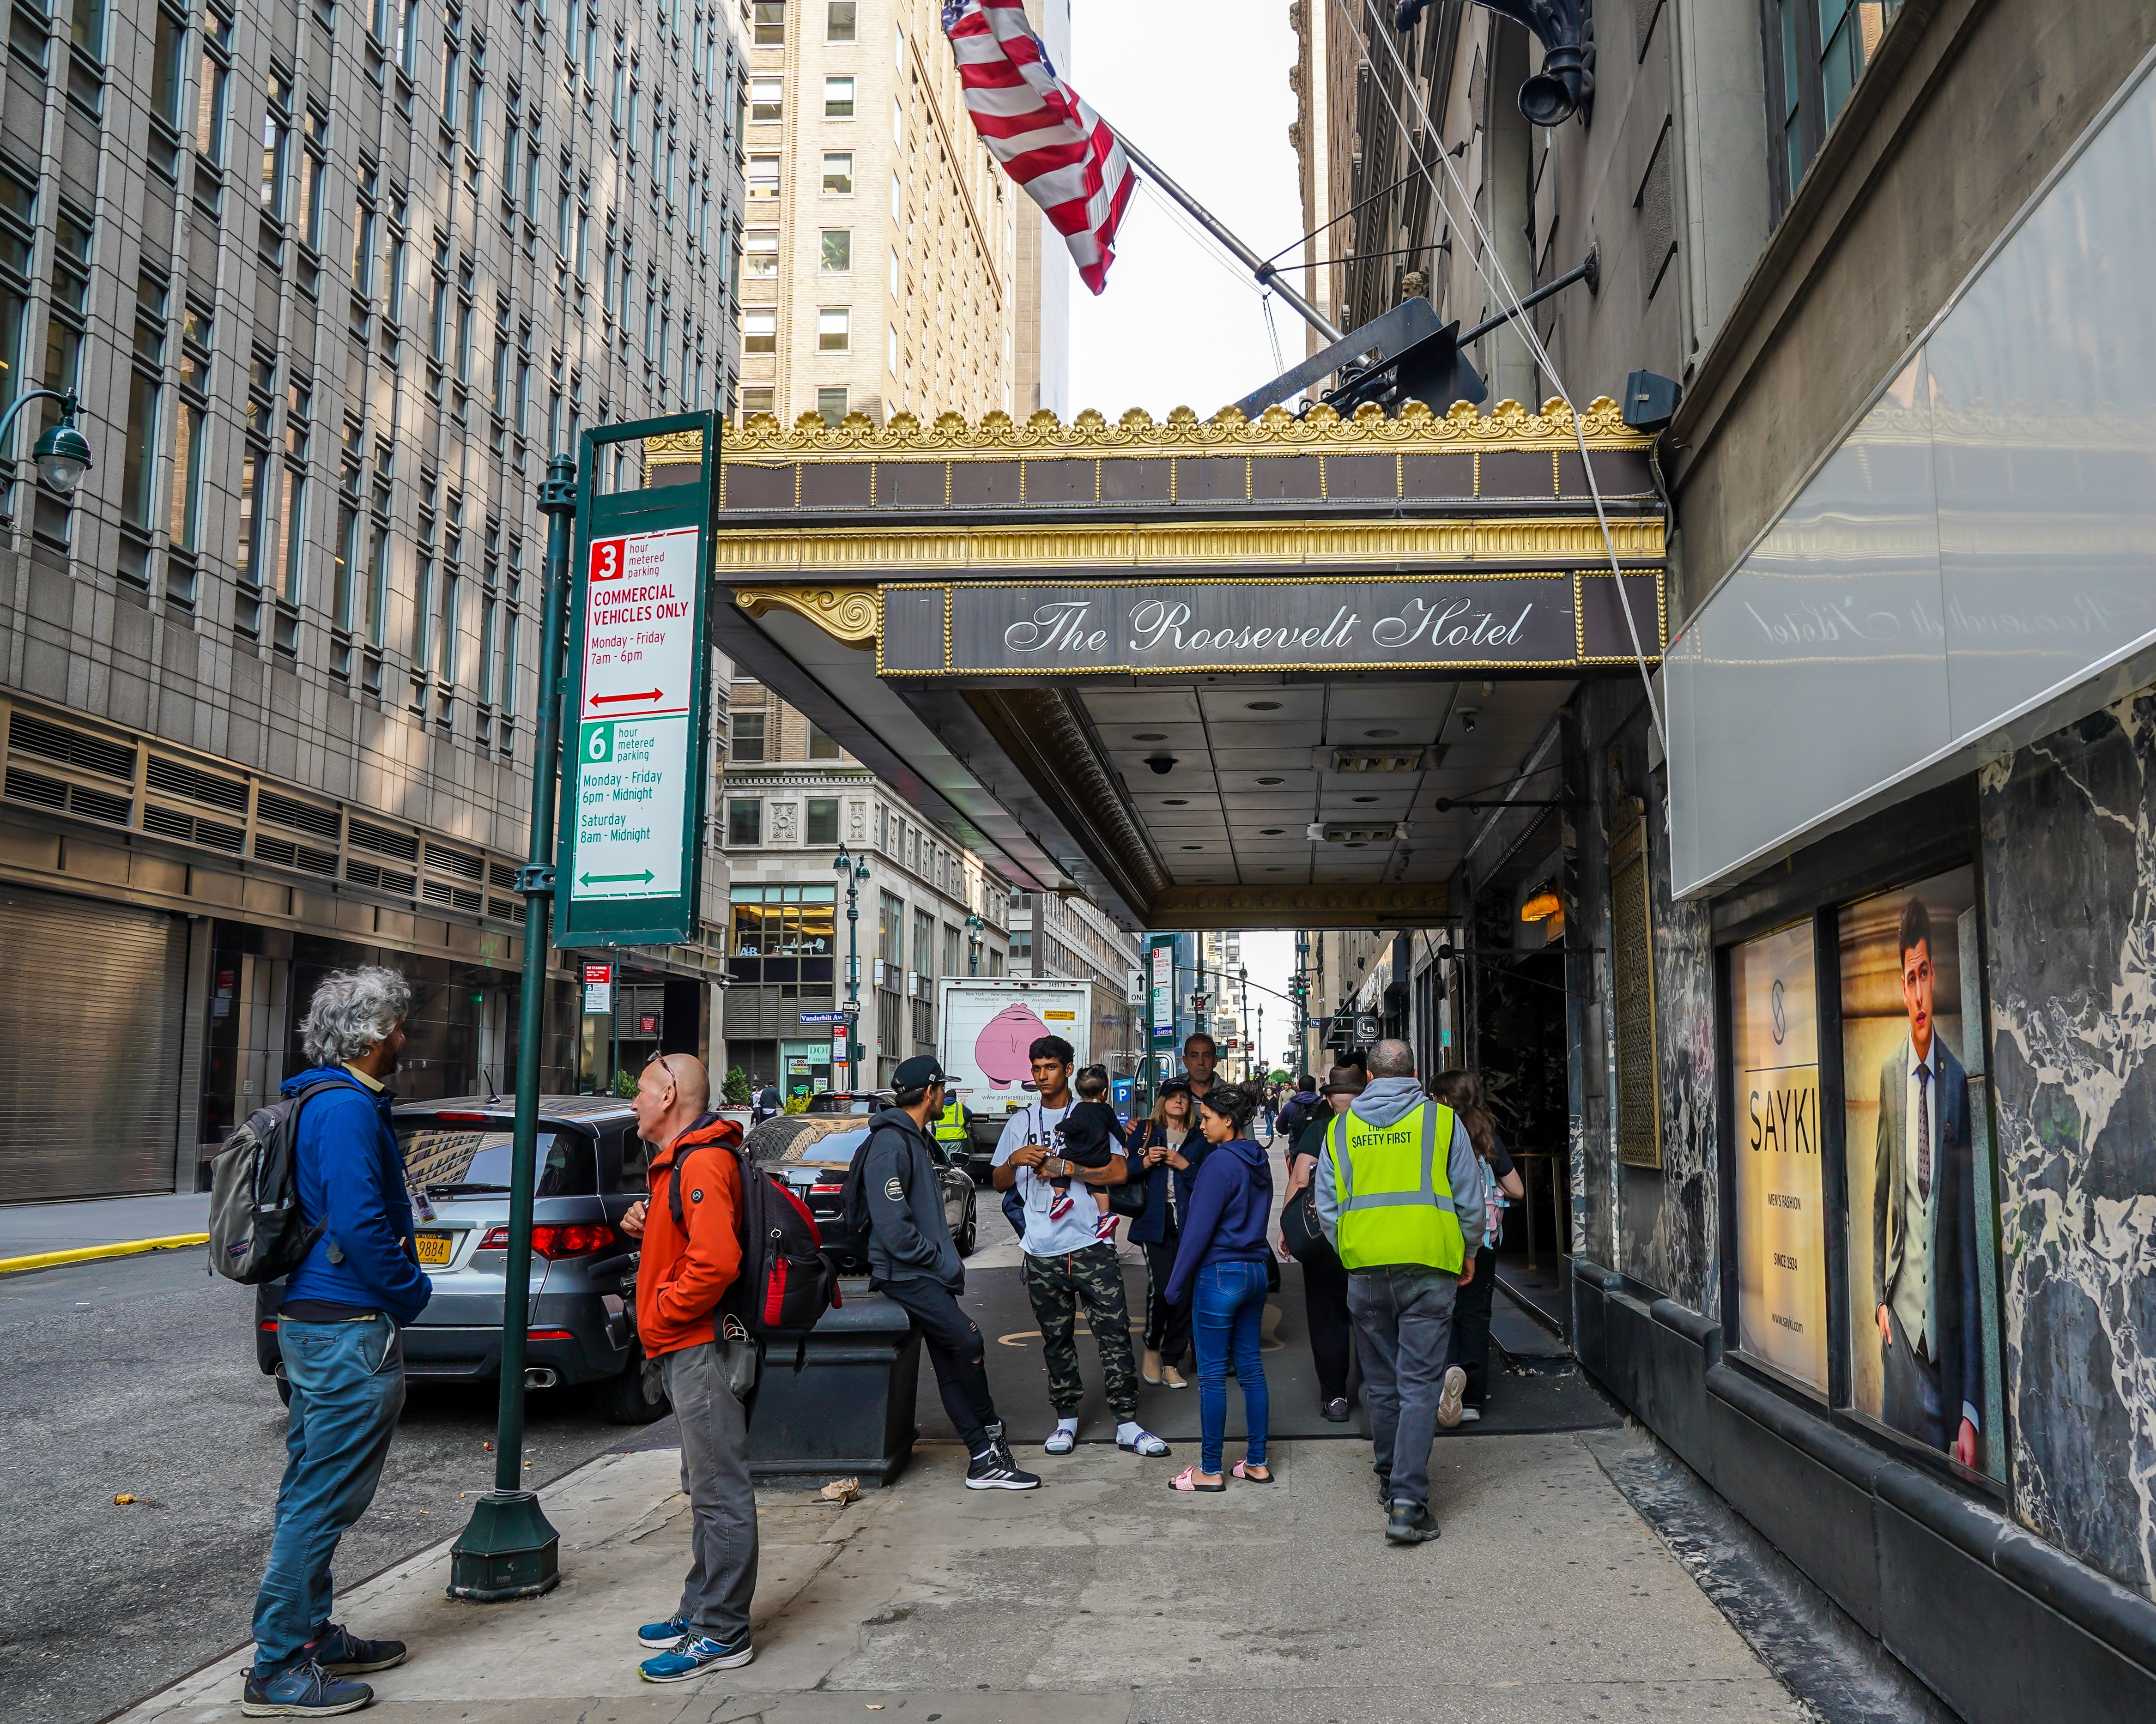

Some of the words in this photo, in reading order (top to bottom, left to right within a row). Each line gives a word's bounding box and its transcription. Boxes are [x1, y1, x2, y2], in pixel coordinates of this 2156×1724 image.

[630, 544, 649, 554] hour
[599, 545, 616, 578] 3
[629, 552, 665, 566] metered
[628, 566, 659, 580] parking
[594, 584, 675, 606] COMMERCIAL
[594, 605, 652, 626] VEHICLES
[656, 602, 689, 619] ONLY
[1004, 601, 1108, 652] The
[1129, 599, 1361, 650] Roosevelt
[1372, 597, 1533, 647] Hotel
[592, 635, 627, 649] Monday
[637, 631, 666, 645] Friday
[592, 653, 610, 665] 7am
[621, 650, 642, 664] 6pm
[619, 728, 638, 738] hour
[589, 726, 606, 760] 6
[618, 737, 654, 750] metered
[618, 750, 649, 763] parking
[583, 773, 622, 787] Monday
[632, 770, 662, 785] Friday
[583, 791, 603, 805] 6pm
[613, 786, 653, 802] Midnight
[581, 813, 626, 827] Saturday
[581, 831, 601, 843] 8am
[611, 827, 650, 843] Midnight
[1363, 1023, 1375, 1032] LB
[1119, 1089, 1127, 1101] P
[1750, 1088, 1817, 1154] SAYKI
[1352, 1134, 1384, 1148] SAFETY
[1387, 1132, 1412, 1144] FIRST
[1768, 1193, 1781, 1207] MEN'S
[1782, 1195, 1801, 1210] FASHION
[1774, 1252, 1786, 1268] SINCE
[1787, 1256, 1798, 1271] 1924
[1771, 1312, 1803, 1334] www.sayki.com
